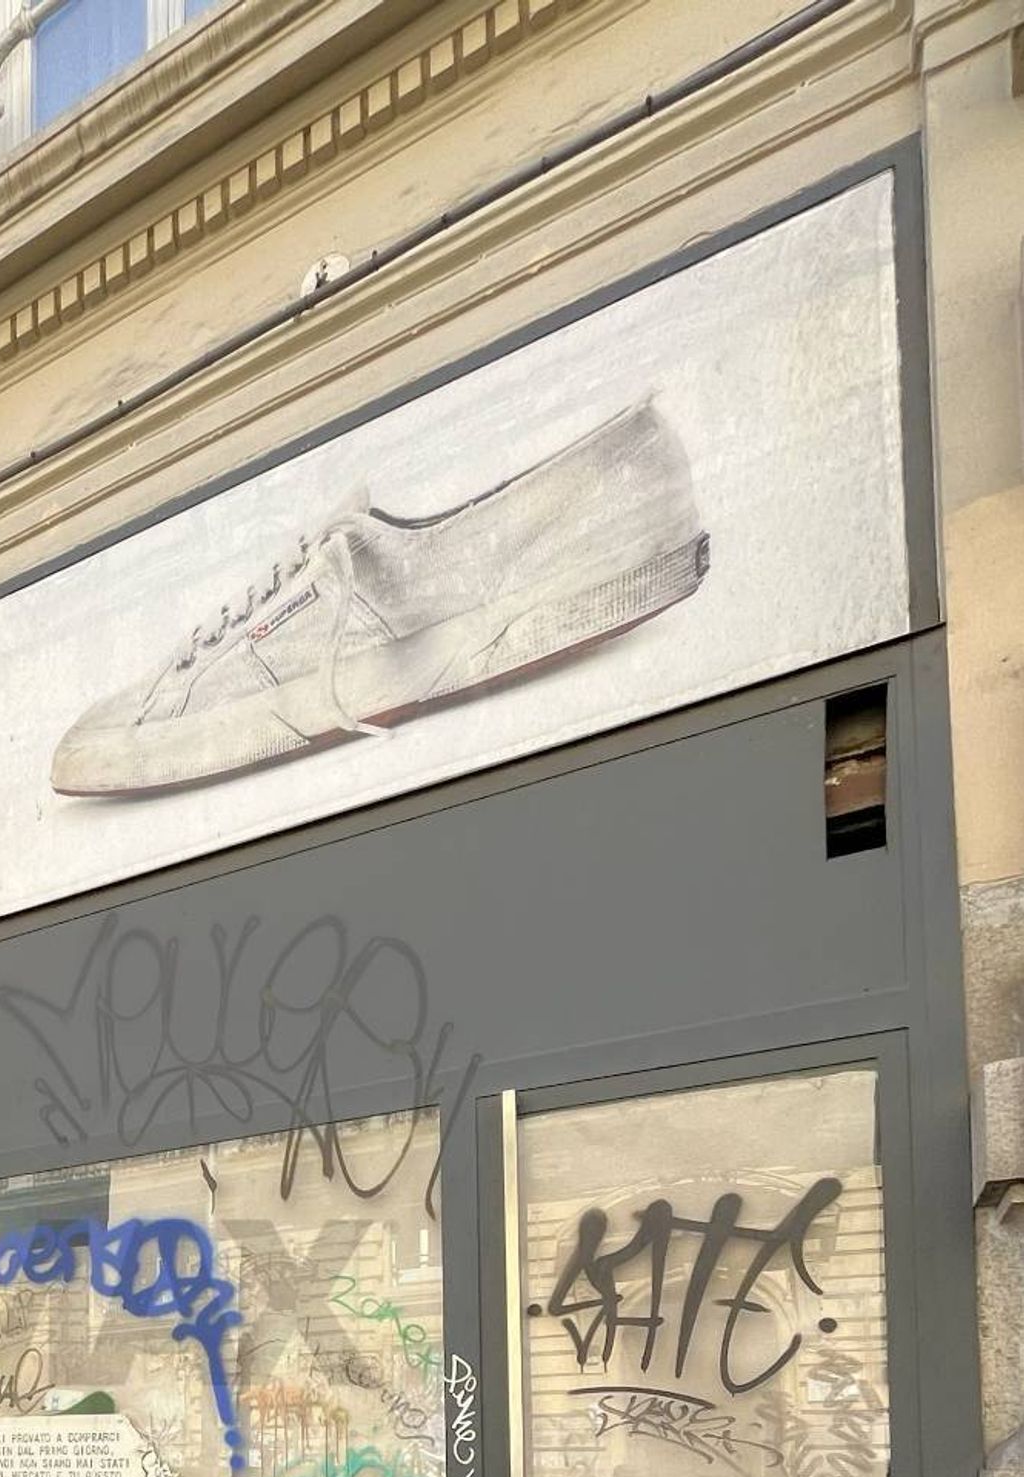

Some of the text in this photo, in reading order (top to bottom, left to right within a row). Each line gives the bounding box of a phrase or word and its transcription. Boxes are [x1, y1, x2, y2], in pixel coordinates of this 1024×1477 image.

[11, 1433, 51, 1443] PROVATO
[56, 1432, 63, 1442] A
[68, 1432, 120, 1442] COMPRARCI
[17, 1446, 34, 1456] DAL
[39, 1446, 68, 1455] PRIMO
[42, 1459, 72, 1469] SIAMO
[76, 1459, 93, 1468] MAI
[99, 1458, 130, 1468] STATI
